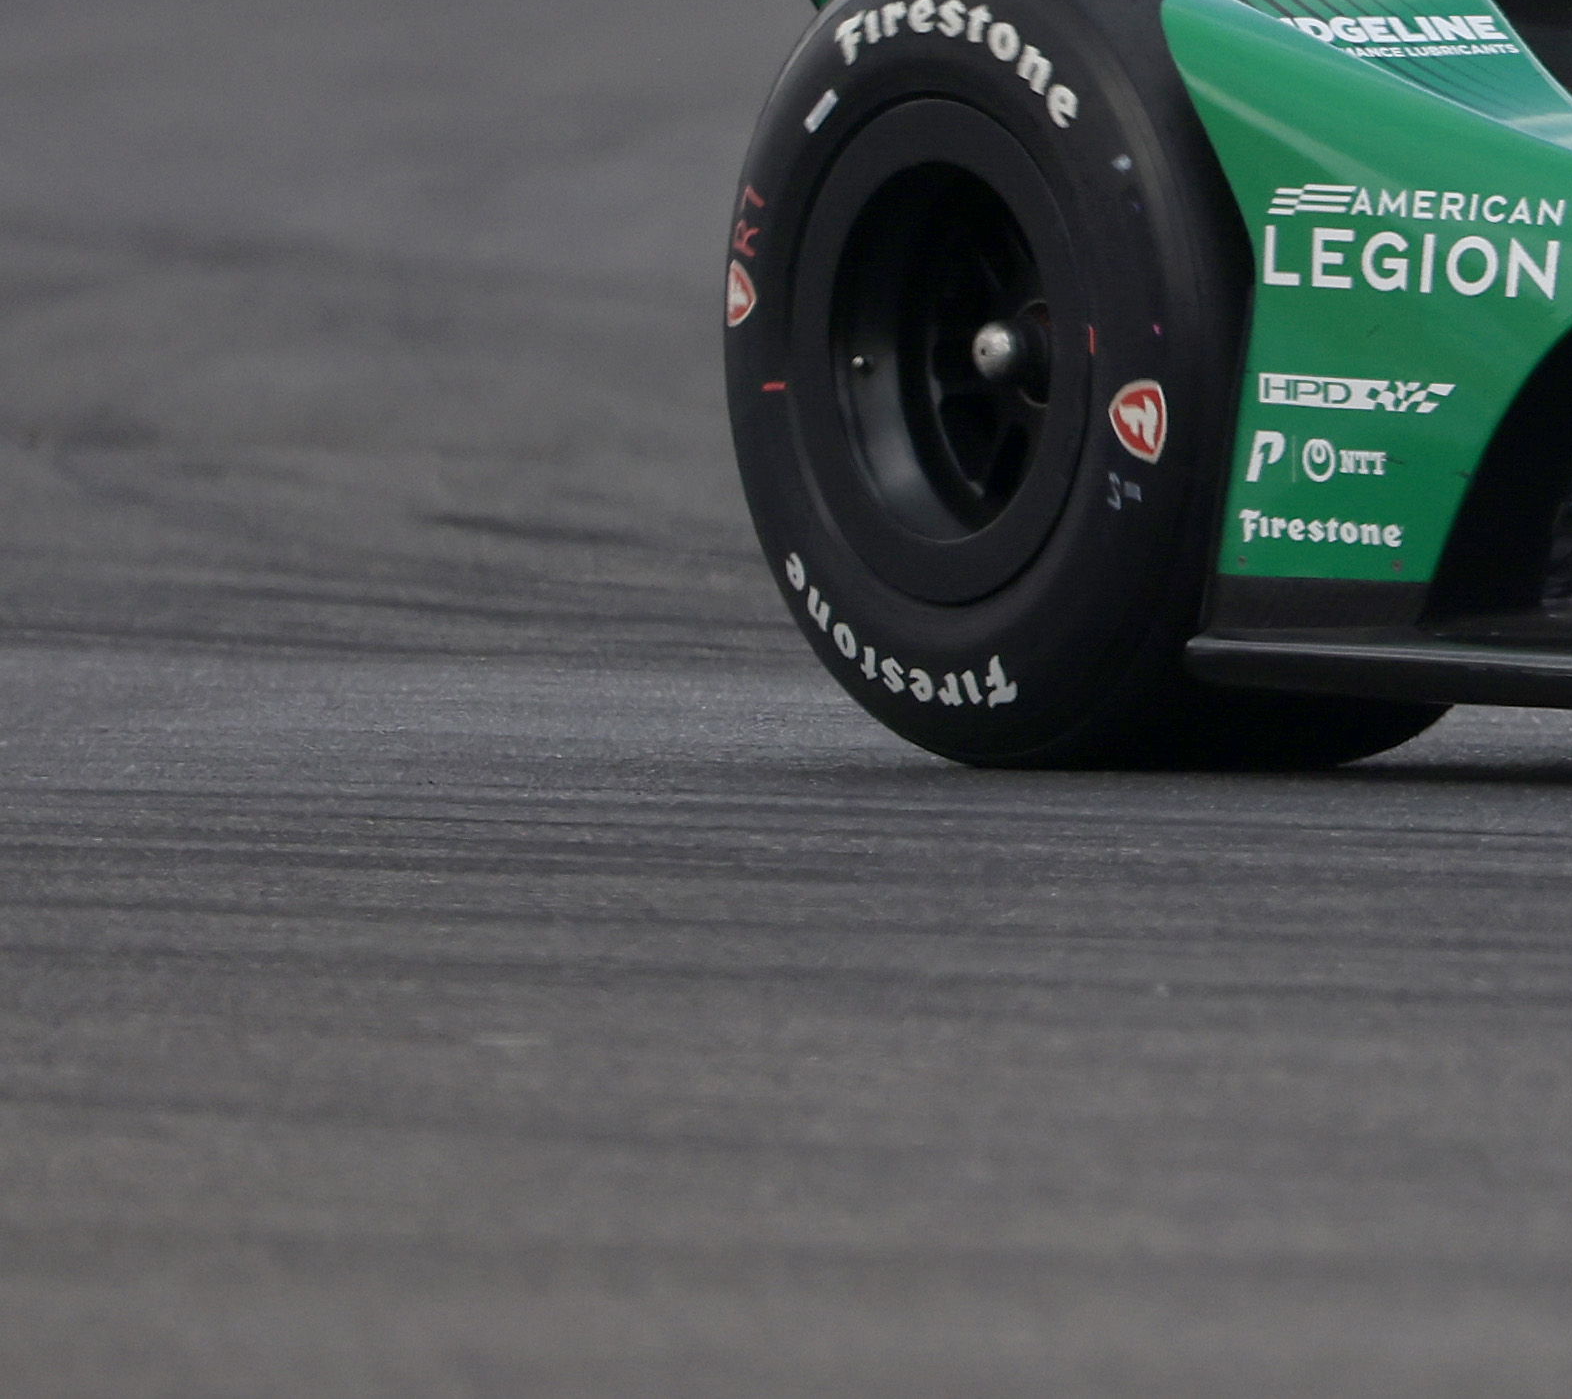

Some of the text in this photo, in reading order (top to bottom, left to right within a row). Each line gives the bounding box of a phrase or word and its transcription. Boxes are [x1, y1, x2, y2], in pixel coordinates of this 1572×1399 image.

[1404, 43, 1521, 59] LUBRICANTS
[1350, 187, 1567, 226] AMERICAN
[1262, 224, 1562, 301] LEGION
[1262, 377, 1352, 405] HPD
[1339, 449, 1388, 477] NTT
[1239, 508, 1403, 548] Firestone
[783, 551, 1020, 711] Firestone
